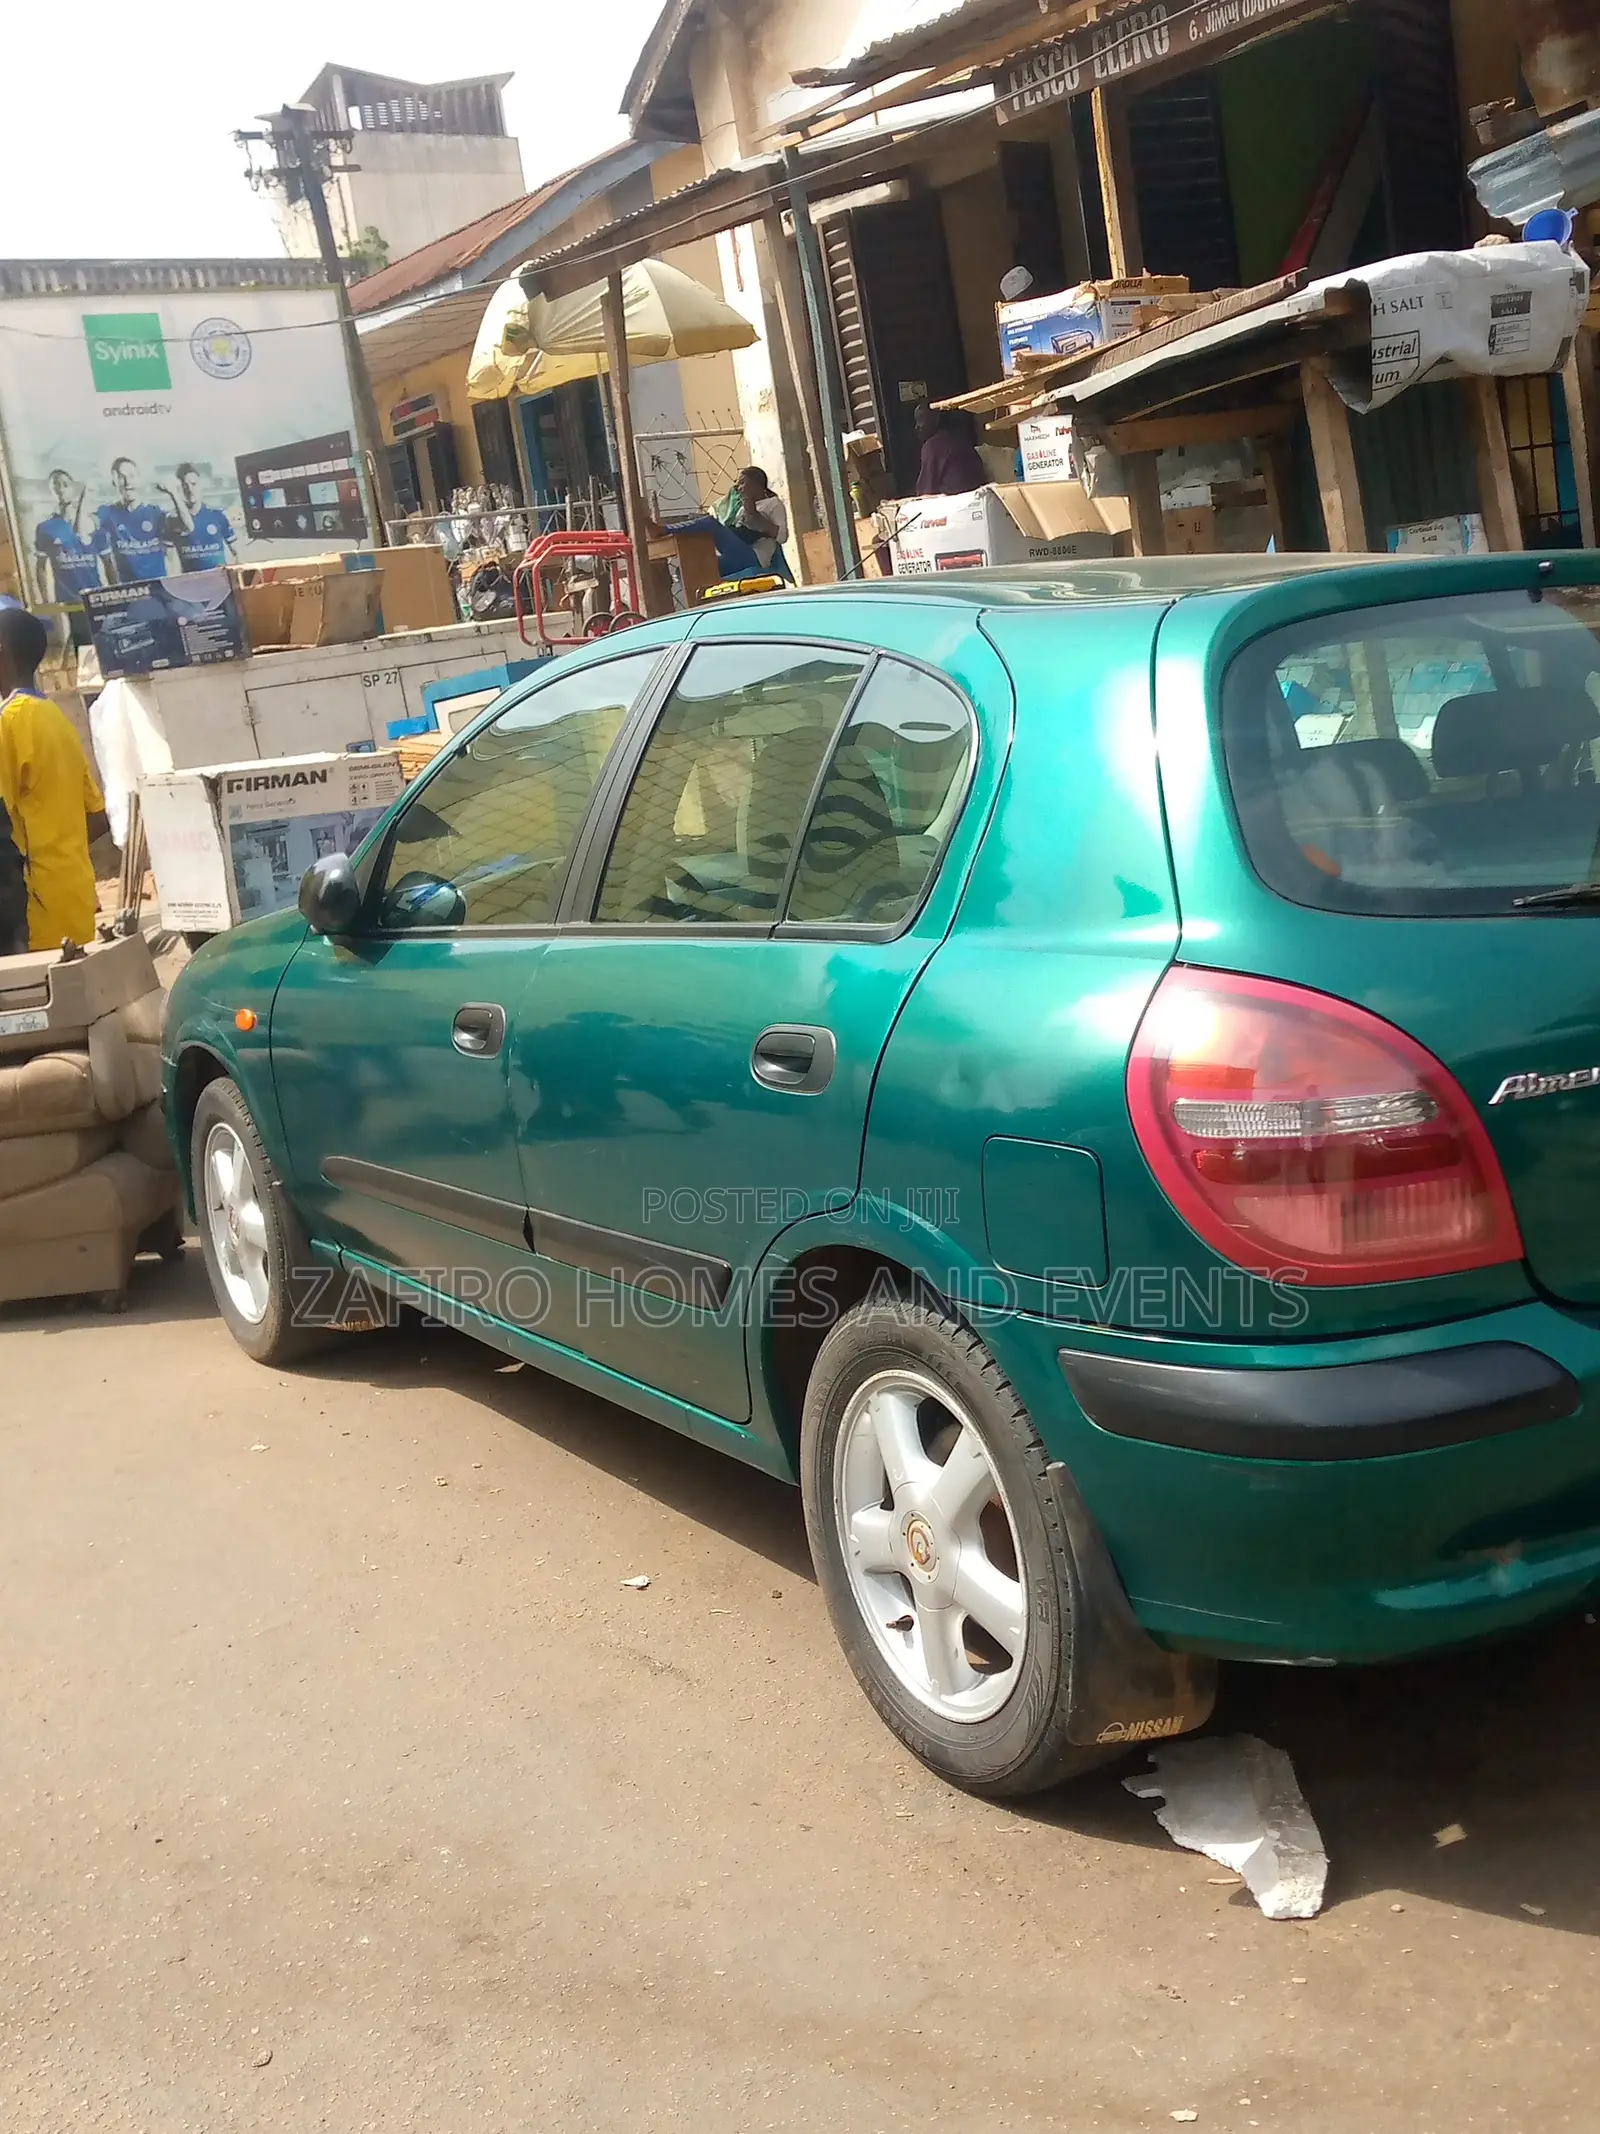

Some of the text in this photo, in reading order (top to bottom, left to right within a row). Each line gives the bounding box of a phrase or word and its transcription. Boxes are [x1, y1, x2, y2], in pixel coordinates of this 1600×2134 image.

[1391, 295, 1425, 314] SALT
[95, 340, 160, 366] Syinix
[1028, 458, 1064, 471] GENERATOR
[898, 560, 932, 574] GENERATOR
[88, 584, 150, 603] FIRMAN
[363, 671, 398, 688] SP 27
[227, 769, 327, 793] FIRMAN
[1124, 1715, 1184, 1741] NISSAN
